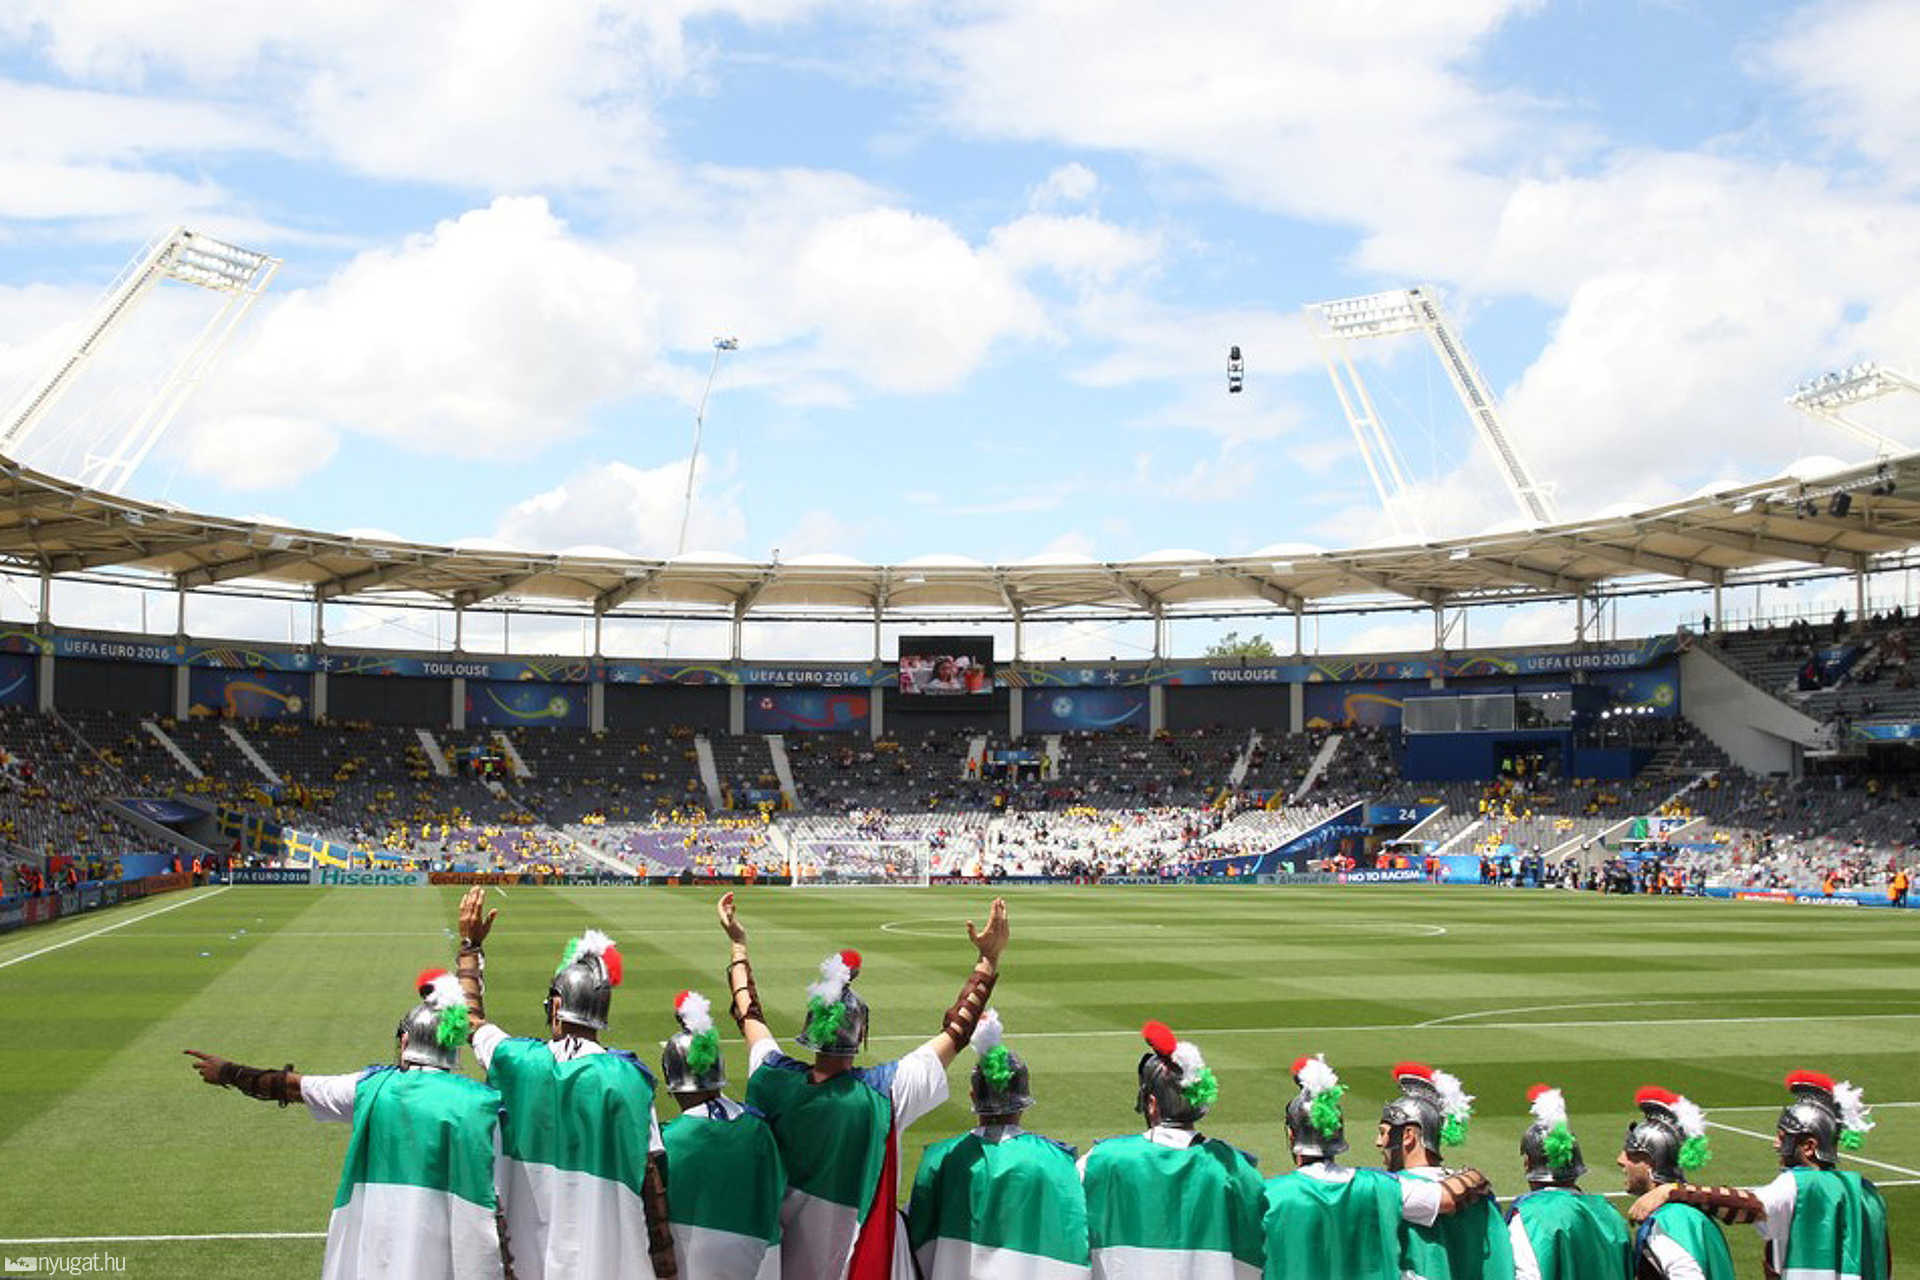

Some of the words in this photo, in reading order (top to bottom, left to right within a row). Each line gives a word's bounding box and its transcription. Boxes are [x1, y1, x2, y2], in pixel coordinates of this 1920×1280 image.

[64, 639, 98, 655] UEFA
[100, 643, 136, 657] EURO
[137, 647, 170, 660] 2016
[1528, 657, 1562, 670] UEFA
[1564, 655, 1600, 668] EURO
[1603, 653, 1636, 666] 2016
[423, 662, 489, 677] TOULOUSE
[1210, 668, 1278, 682] TOULOUSE
[749, 670, 785, 682] UEFA
[786, 671, 823, 682] EURO
[824, 671, 860, 684] 2016
[1398, 808, 1417, 821] 24
[281, 871, 308, 881] 2016
[320, 868, 417, 885] Hisense
[1348, 872, 1364, 882] NO
[1366, 871, 1380, 882] TO
[1381, 869, 1420, 881] RACISM
